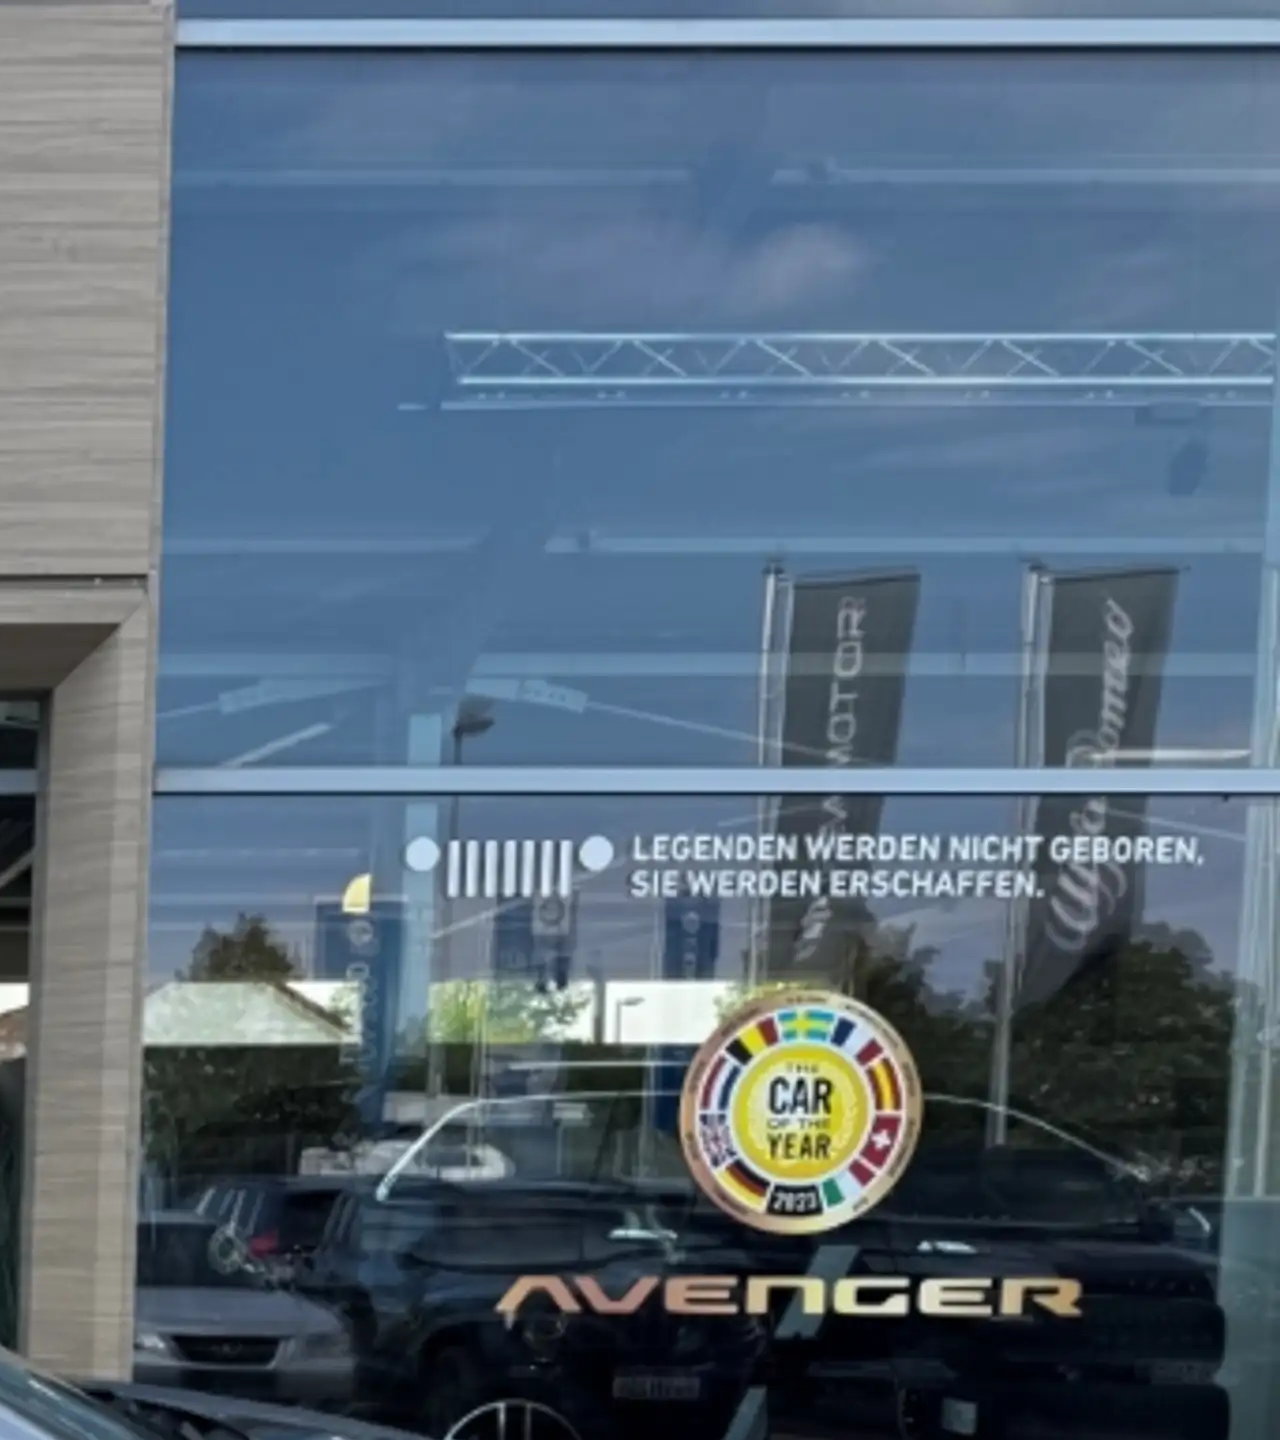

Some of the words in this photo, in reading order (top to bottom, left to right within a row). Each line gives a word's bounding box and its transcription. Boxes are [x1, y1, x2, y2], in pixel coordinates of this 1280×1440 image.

[632, 834, 798, 862] LEGENDEN
[804, 834, 940, 862] WERDEN
[949, 835, 1045, 862] NICHT
[1049, 835, 1205, 866] GEBOREN,
[630, 869, 679, 898] SIE
[687, 869, 821, 898] WERDEN
[828, 869, 1046, 899] ERSCHAFFEN.
[768, 1076, 834, 1116] CAR
[767, 1133, 832, 1161] YEAR
[495, 1273, 1083, 1319] AVENGER
